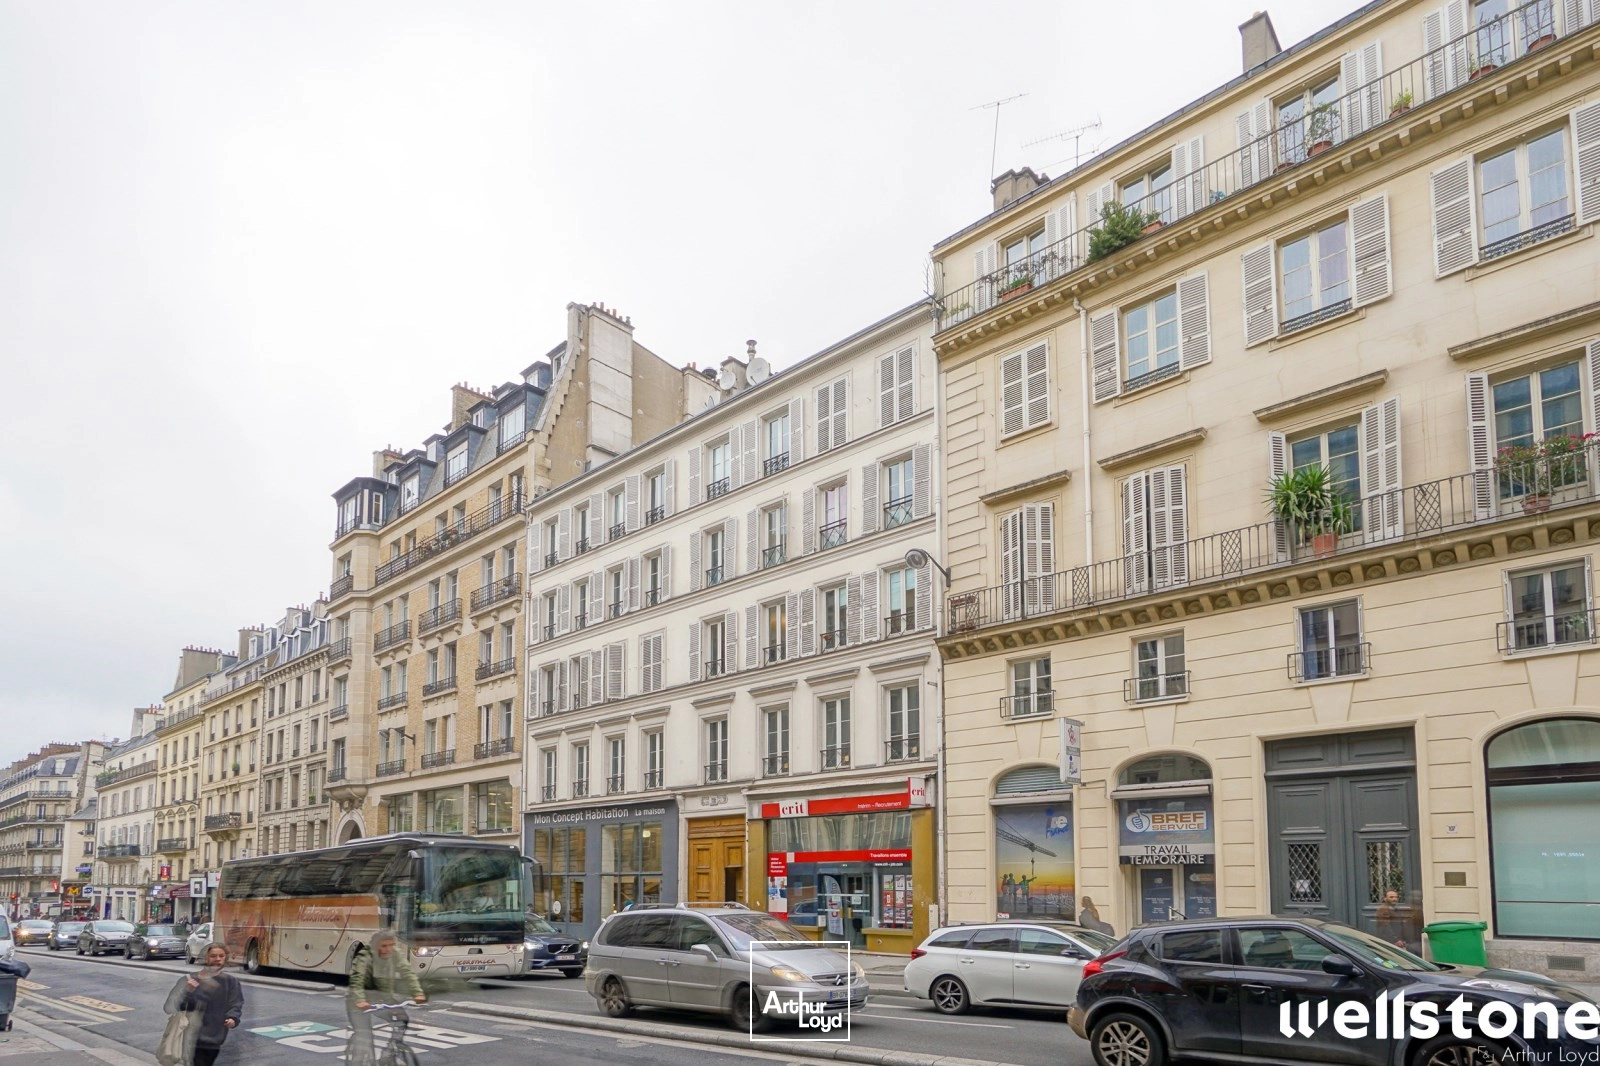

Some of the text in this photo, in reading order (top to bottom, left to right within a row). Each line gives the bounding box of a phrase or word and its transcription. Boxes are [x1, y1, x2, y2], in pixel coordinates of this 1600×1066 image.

[781, 802, 804, 815] crit
[534, 814, 550, 824] Mon
[552, 810, 584, 823] Concept
[585, 807, 629, 820] Habitation
[643, 807, 666, 815] maison
[1151, 812, 1205, 824] BREF
[1151, 823, 1205, 831] SERVICE
[1144, 845, 1190, 854] TRAVAIL
[1129, 854, 1205, 865] TEMPORAIRE
